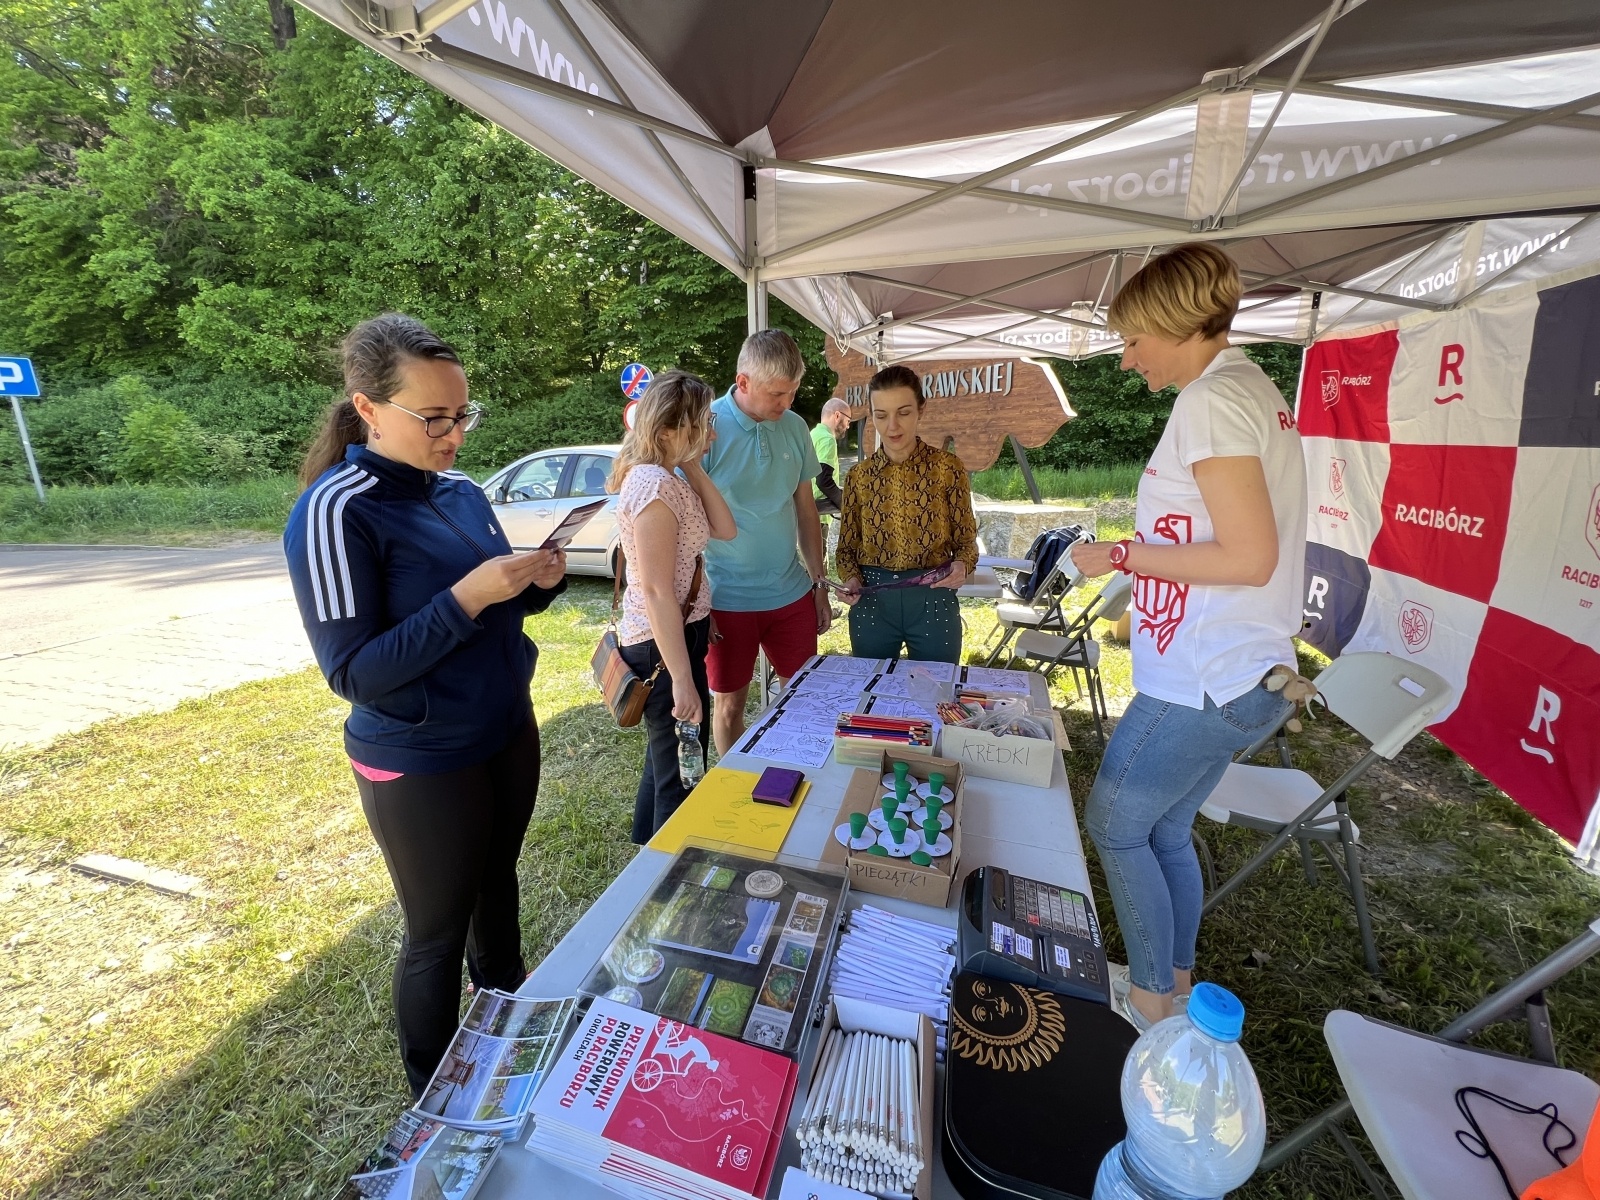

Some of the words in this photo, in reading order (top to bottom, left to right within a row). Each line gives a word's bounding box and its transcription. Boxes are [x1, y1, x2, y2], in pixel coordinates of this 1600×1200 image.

[0, 361, 24, 391] P
[1438, 343, 1465, 387] R
[845, 383, 871, 407] BRA
[921, 361, 1013, 399] RAWSKIEJ
[1277, 409, 1300, 432] RA
[1395, 503, 1485, 538] RACIBÓRZ
[1307, 575, 1329, 609] R
[1561, 565, 1600, 589] RACIB
[1528, 684, 1561, 745] R
[962, 739, 1030, 766] KREDKI
[853, 863, 927, 888] PIECZĄTKI
[572, 1018, 602, 1061] OKOLICACH
[600, 1017, 618, 1034] PO
[559, 1035, 608, 1109] RACIBORZU
[584, 1021, 632, 1096] ROWEROWY
[592, 1025, 645, 1112] PRZEWODNIK
[717, 1134, 732, 1168] RACIBÓRZ
